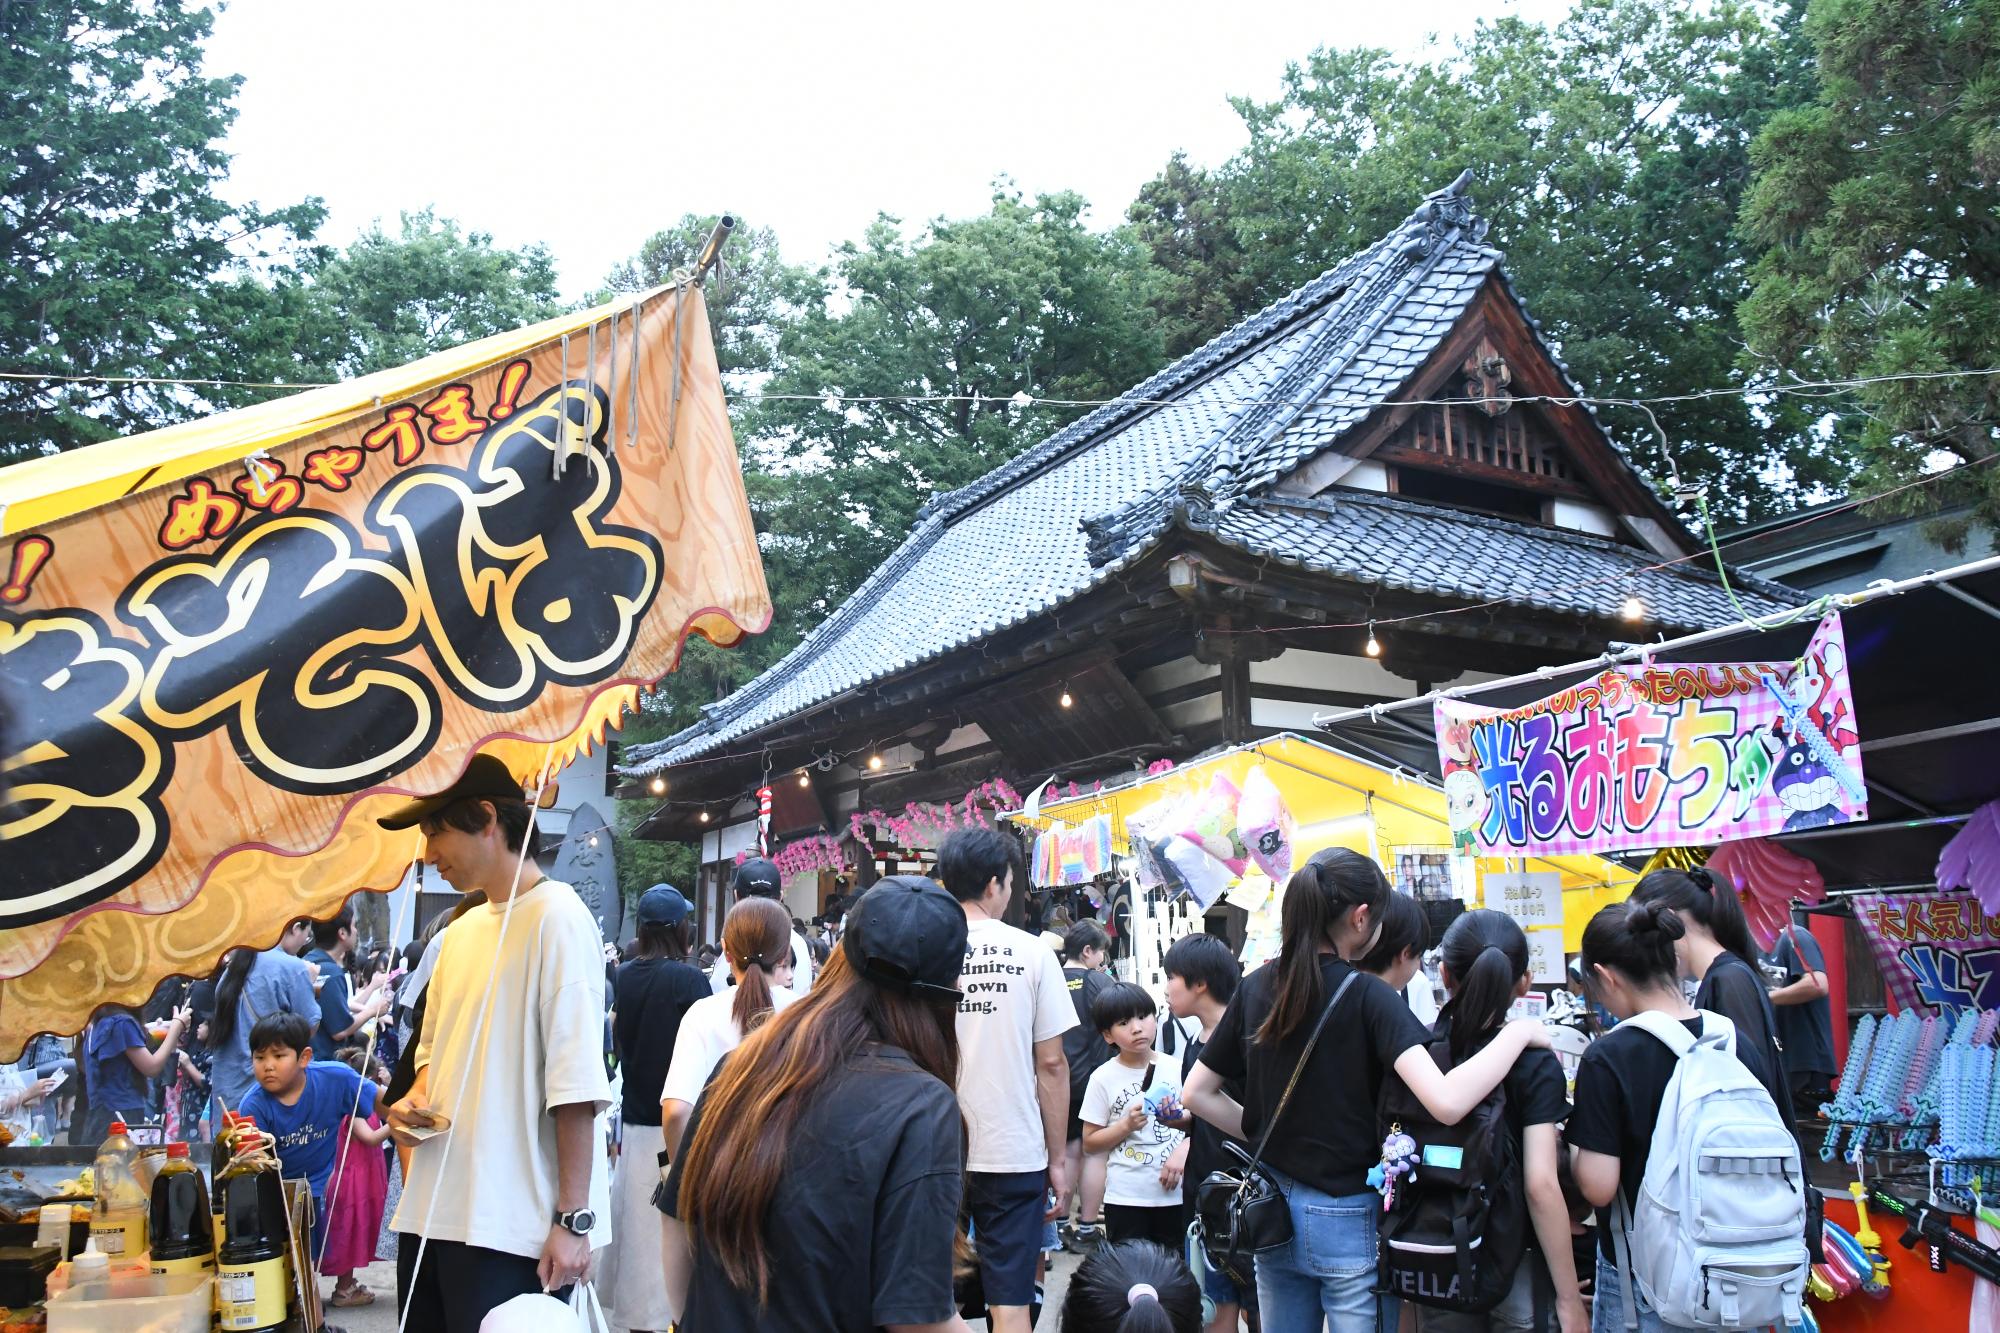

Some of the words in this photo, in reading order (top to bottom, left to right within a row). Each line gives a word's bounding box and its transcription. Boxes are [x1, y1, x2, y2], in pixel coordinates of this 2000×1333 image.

[1471, 699, 1773, 847] 光るおもちゃ
[982, 943, 998, 956] is
[1003, 946, 1013, 957] a
[960, 960, 1025, 976] dmirer
[967, 982, 1008, 994] own
